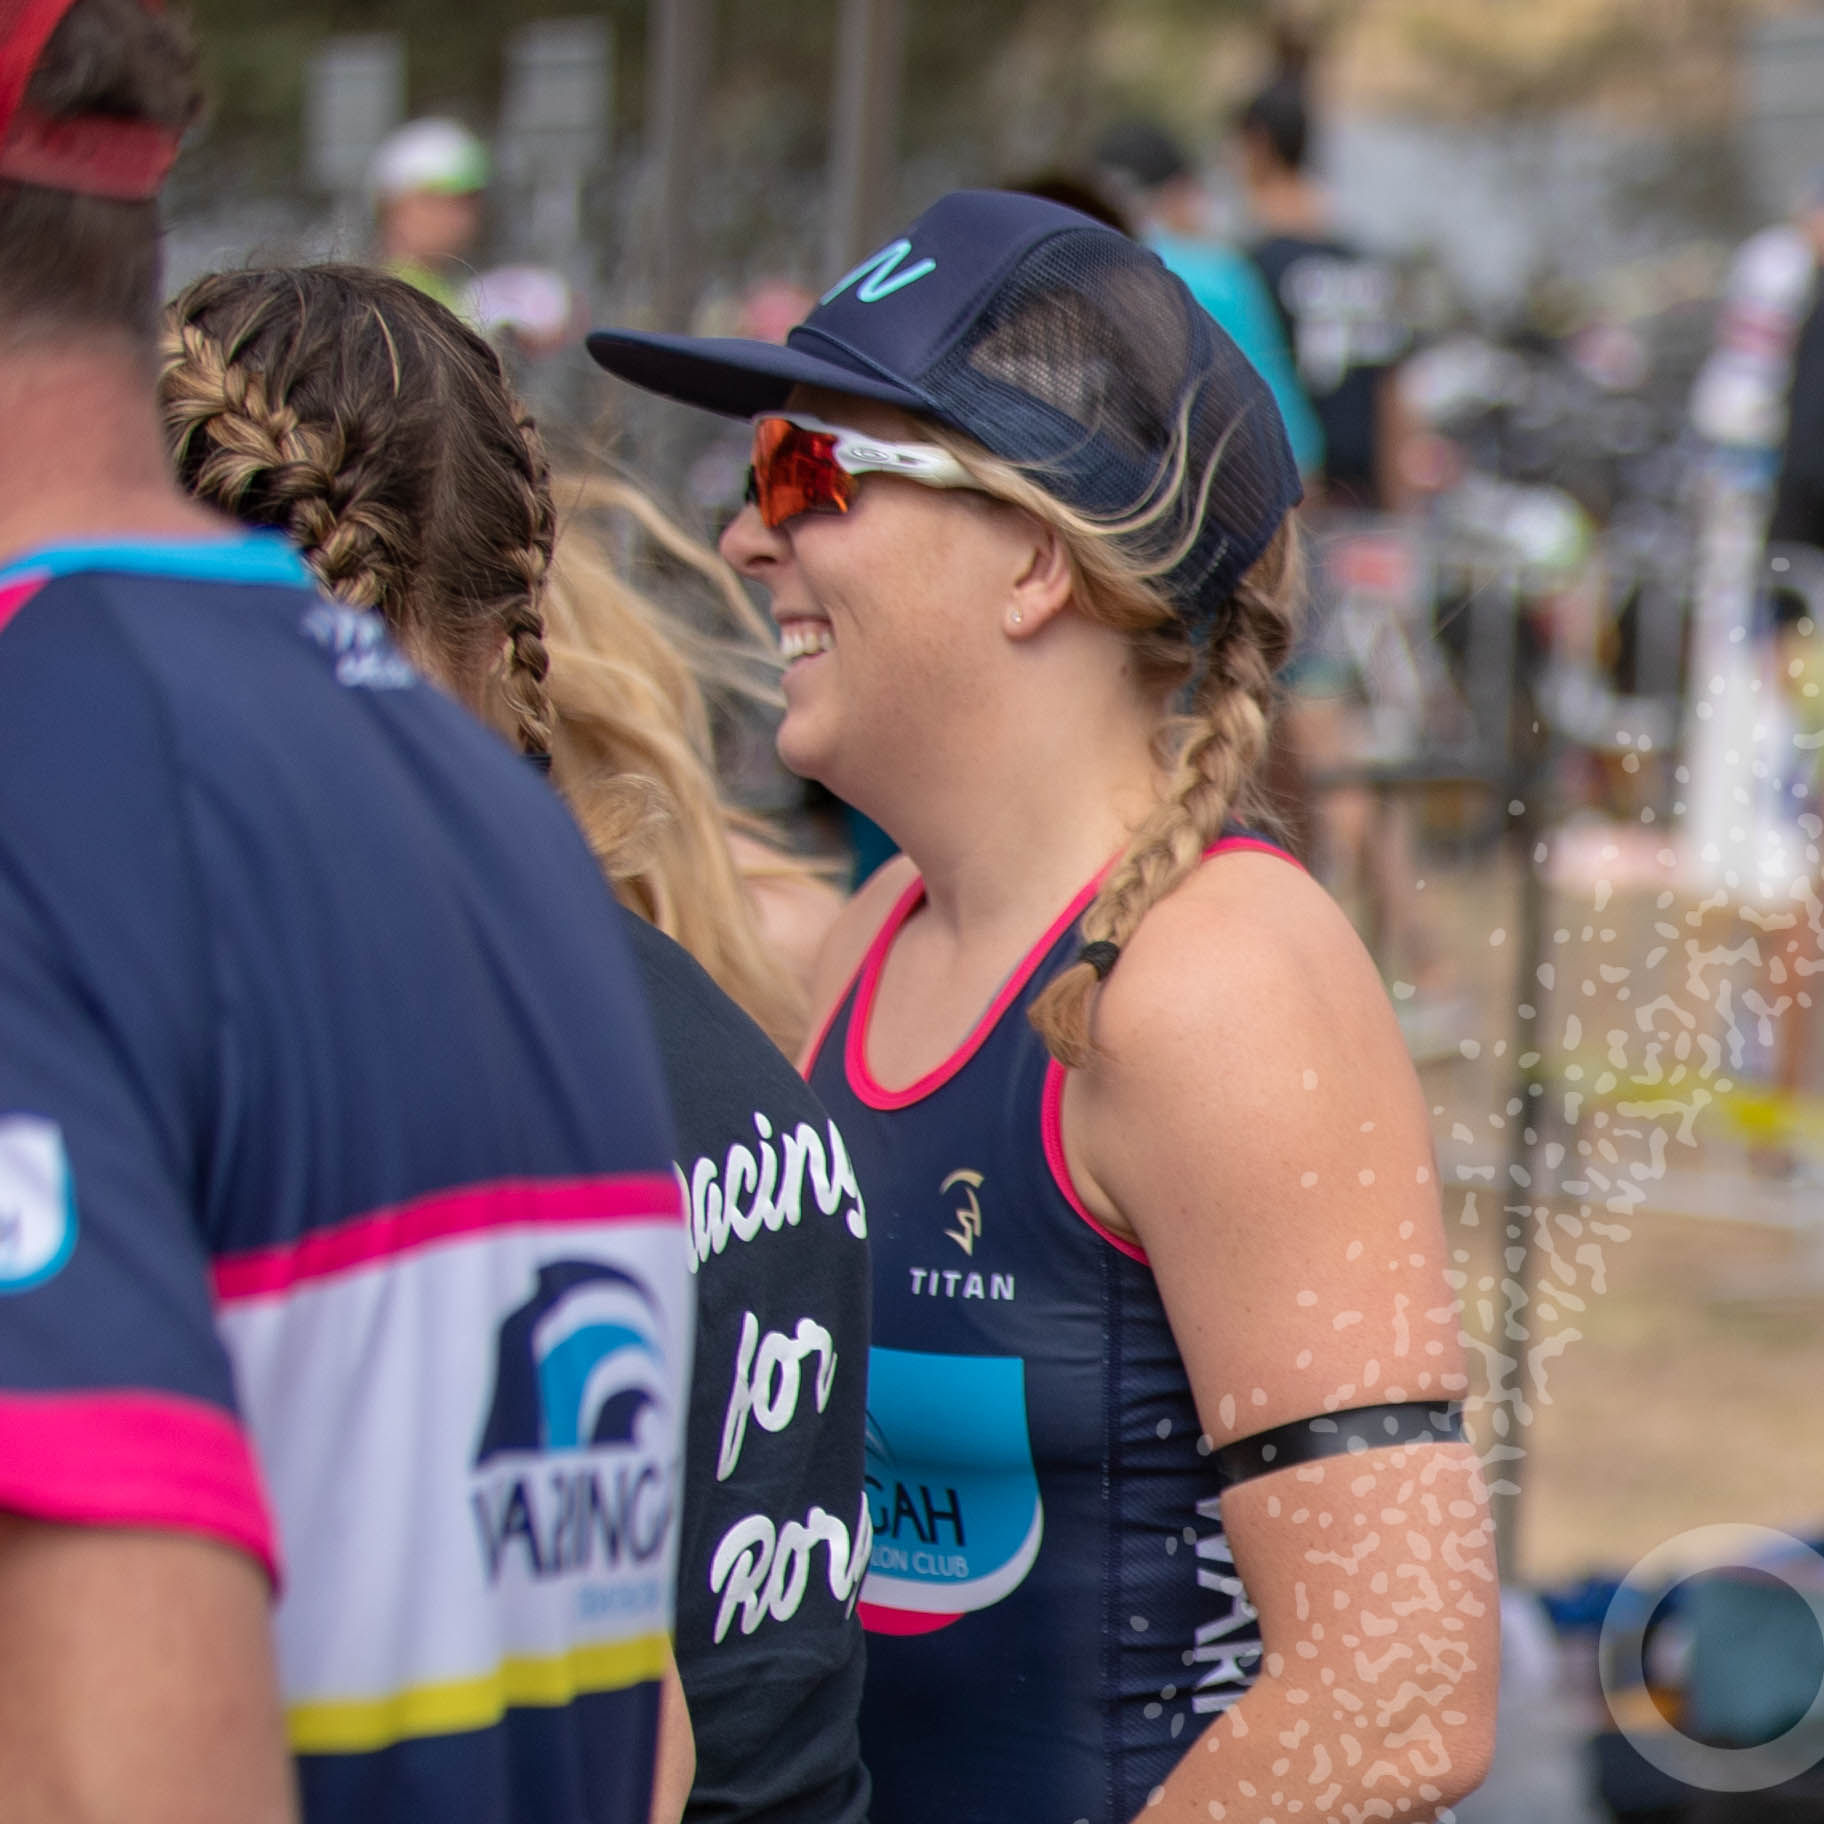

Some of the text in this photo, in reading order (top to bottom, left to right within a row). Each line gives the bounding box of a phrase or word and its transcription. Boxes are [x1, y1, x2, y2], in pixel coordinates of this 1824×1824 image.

[674, 1111, 868, 1273] acing
[908, 1267, 1016, 1301] TITAN
[716, 1310, 837, 1482] for
[911, 1551, 969, 1579] CLUB
